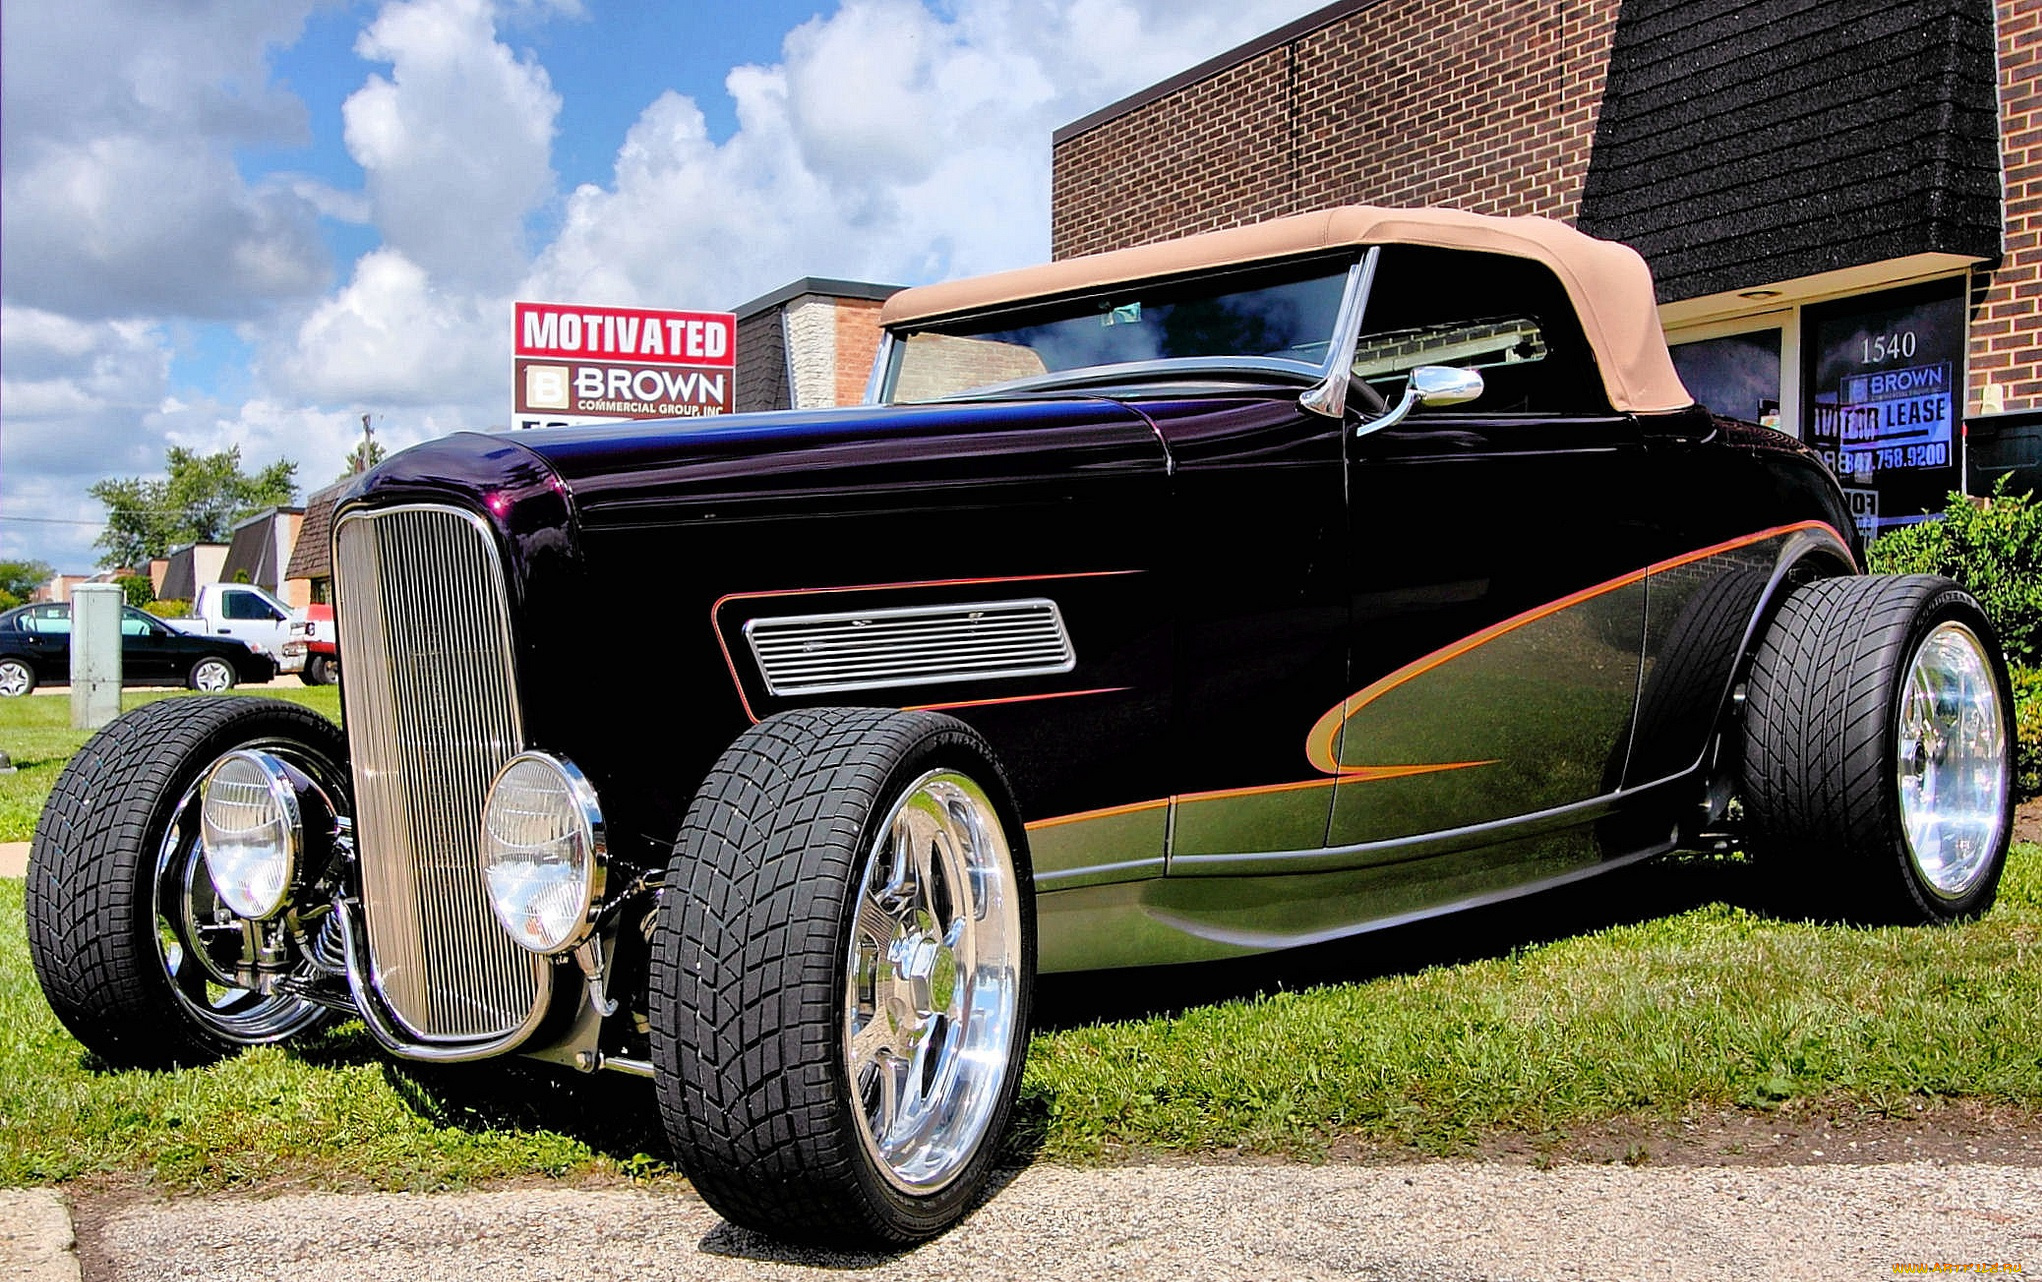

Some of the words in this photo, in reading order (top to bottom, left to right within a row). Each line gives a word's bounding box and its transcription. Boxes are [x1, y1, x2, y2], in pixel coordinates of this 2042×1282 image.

[523, 311, 727, 358] MOTIVATED
[1861, 331, 1916, 364] 1540
[573, 367, 725, 404] BROWN
[1871, 366, 1942, 395] BROWN
[577, 400, 655, 415] COMMERCIAL
[1886, 398, 1945, 427] LEASE
